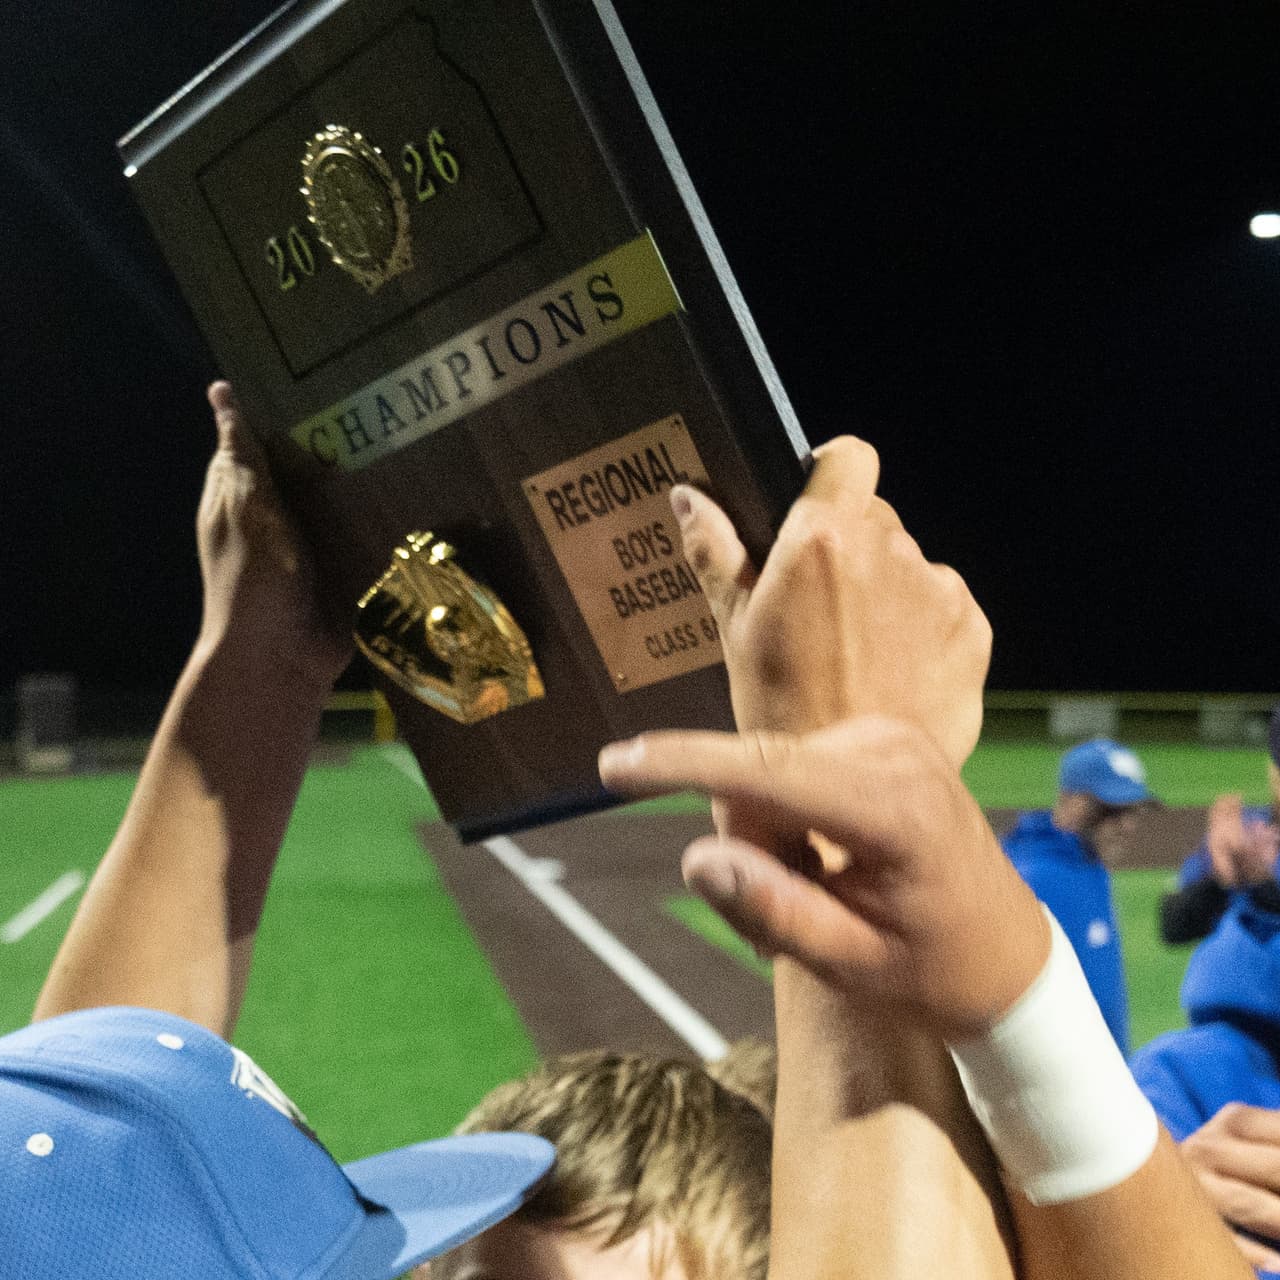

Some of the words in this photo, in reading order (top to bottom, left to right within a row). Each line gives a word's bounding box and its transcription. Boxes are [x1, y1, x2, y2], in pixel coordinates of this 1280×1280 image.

[268, 226, 315, 290] 20
[404, 129, 459, 201] 26
[309, 271, 624, 458] CHAMPIONS
[546, 442, 689, 531] REGIONAL
[612, 521, 673, 570] BOYS
[645, 623, 699, 659] CLASS
